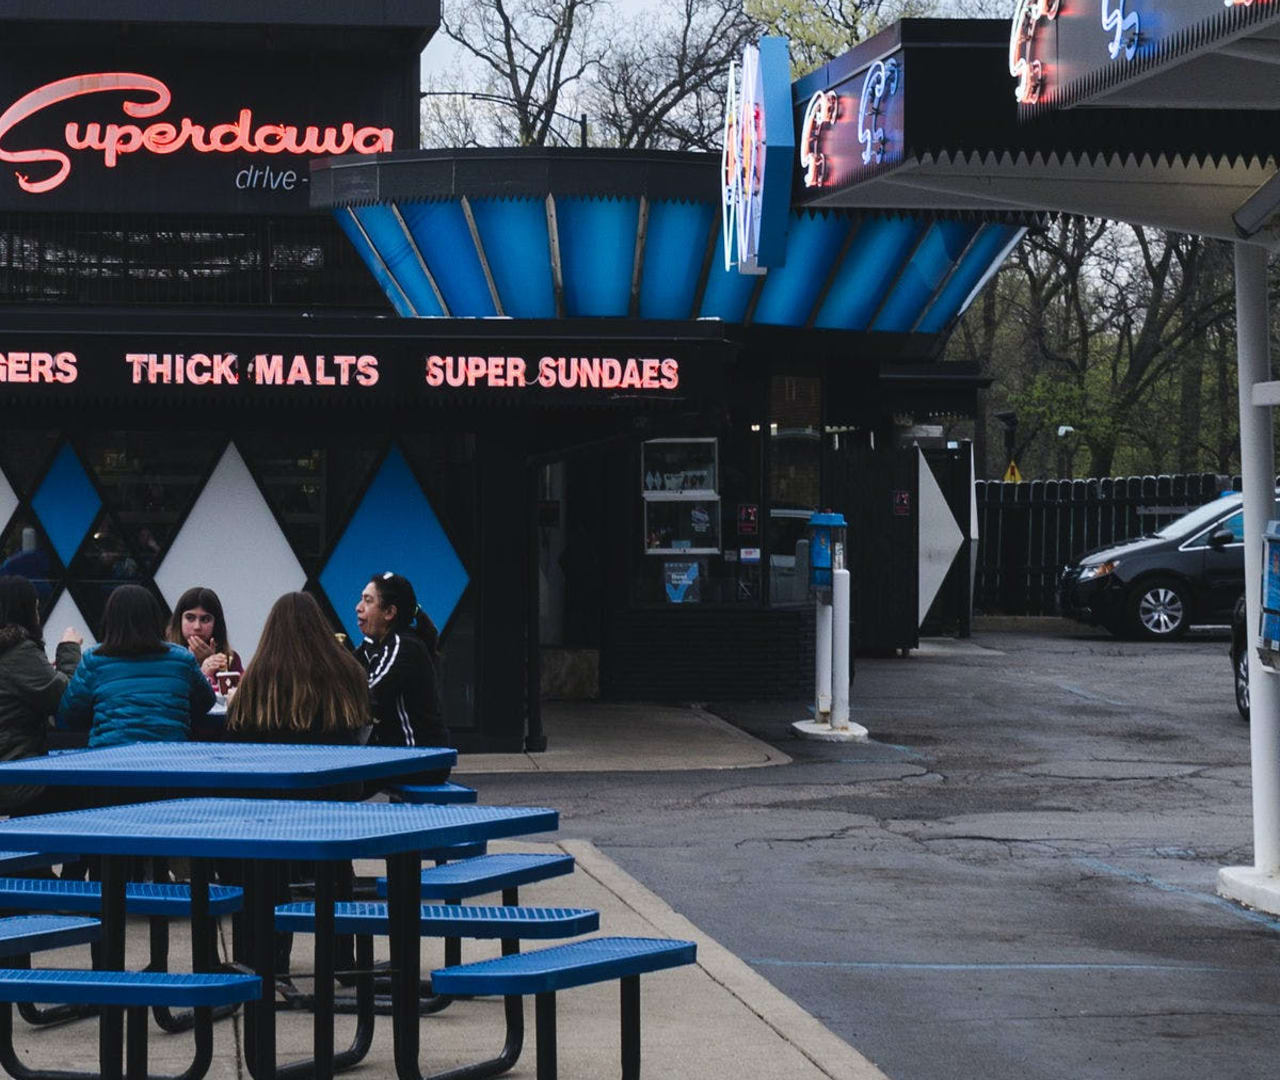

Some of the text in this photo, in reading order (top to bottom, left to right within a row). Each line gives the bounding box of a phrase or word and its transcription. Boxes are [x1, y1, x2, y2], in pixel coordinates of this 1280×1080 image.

[125, 353, 380, 387] THICK MALTS
[426, 355, 680, 390] SUPER SUNDAES
